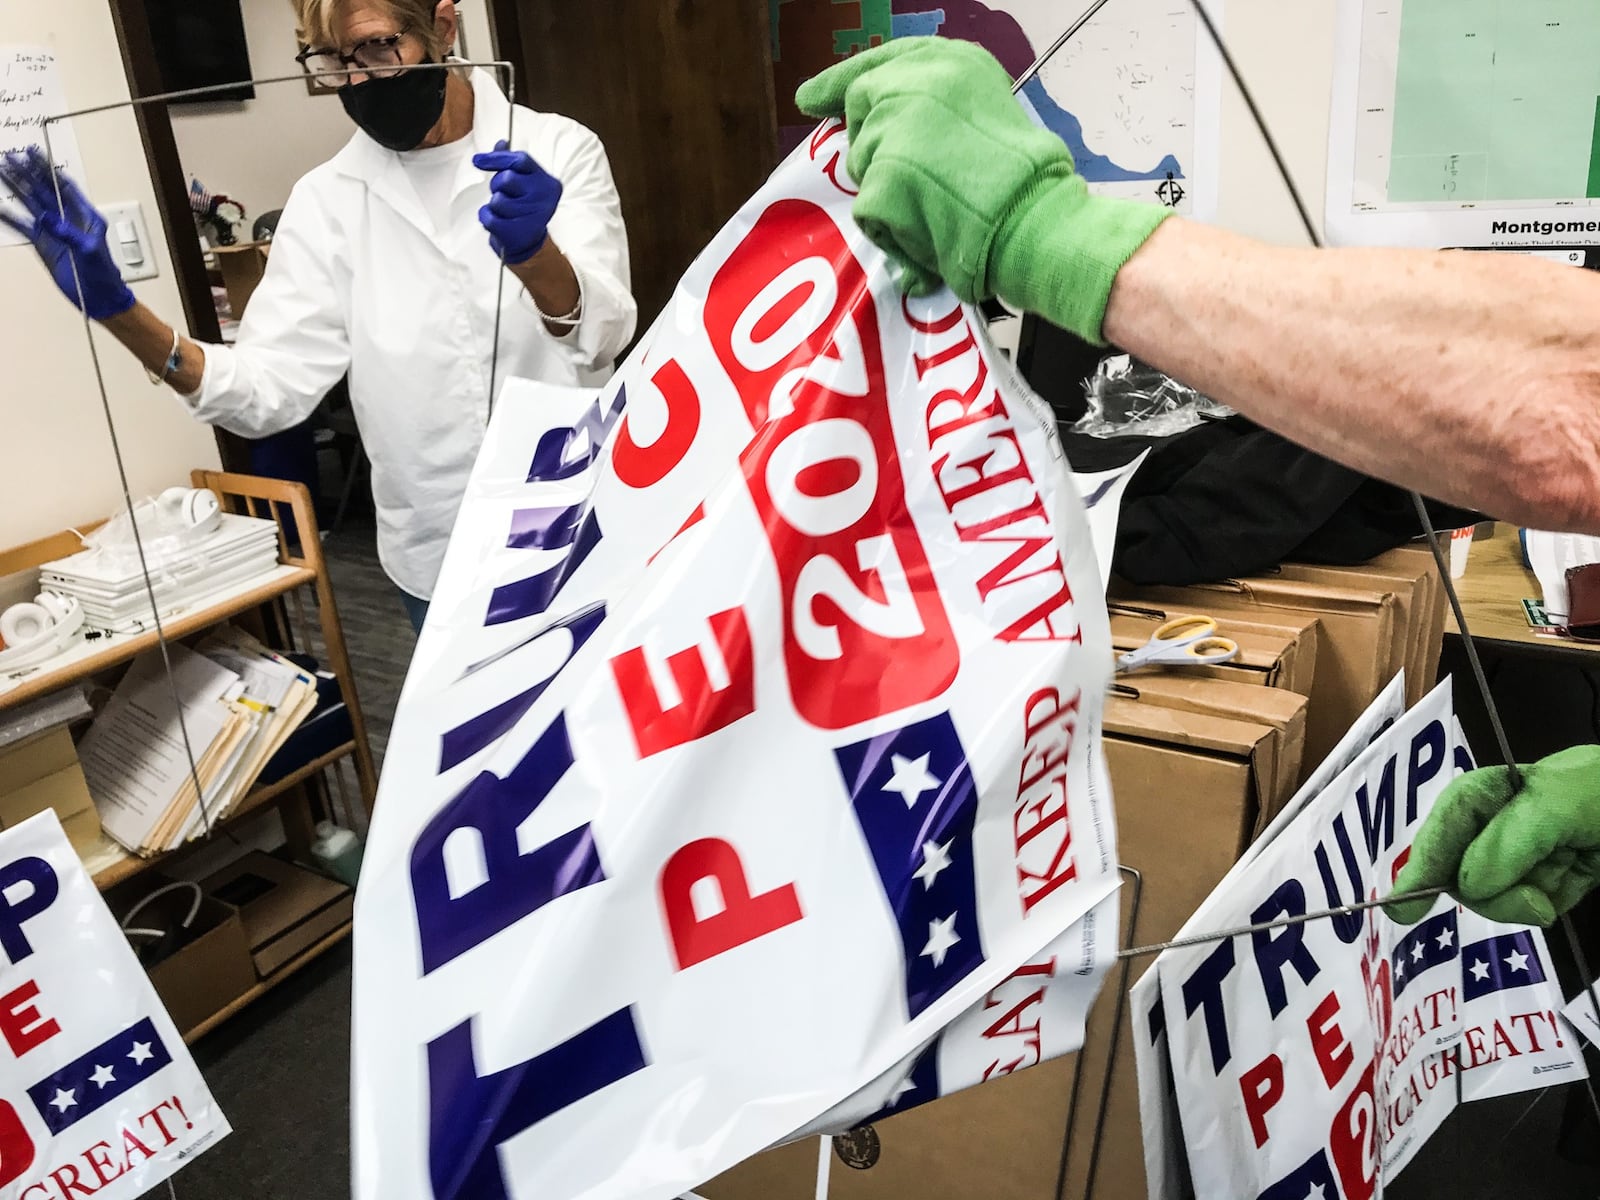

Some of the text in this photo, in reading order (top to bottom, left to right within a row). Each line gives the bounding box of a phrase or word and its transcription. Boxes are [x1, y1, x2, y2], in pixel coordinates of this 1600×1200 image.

[1492, 221, 1600, 235] Montgome
[902, 290, 1082, 920] KEEP AMERIC
[1182, 720, 1446, 1076] TRUMP
[1421, 1009, 1564, 1090] GREAT!
